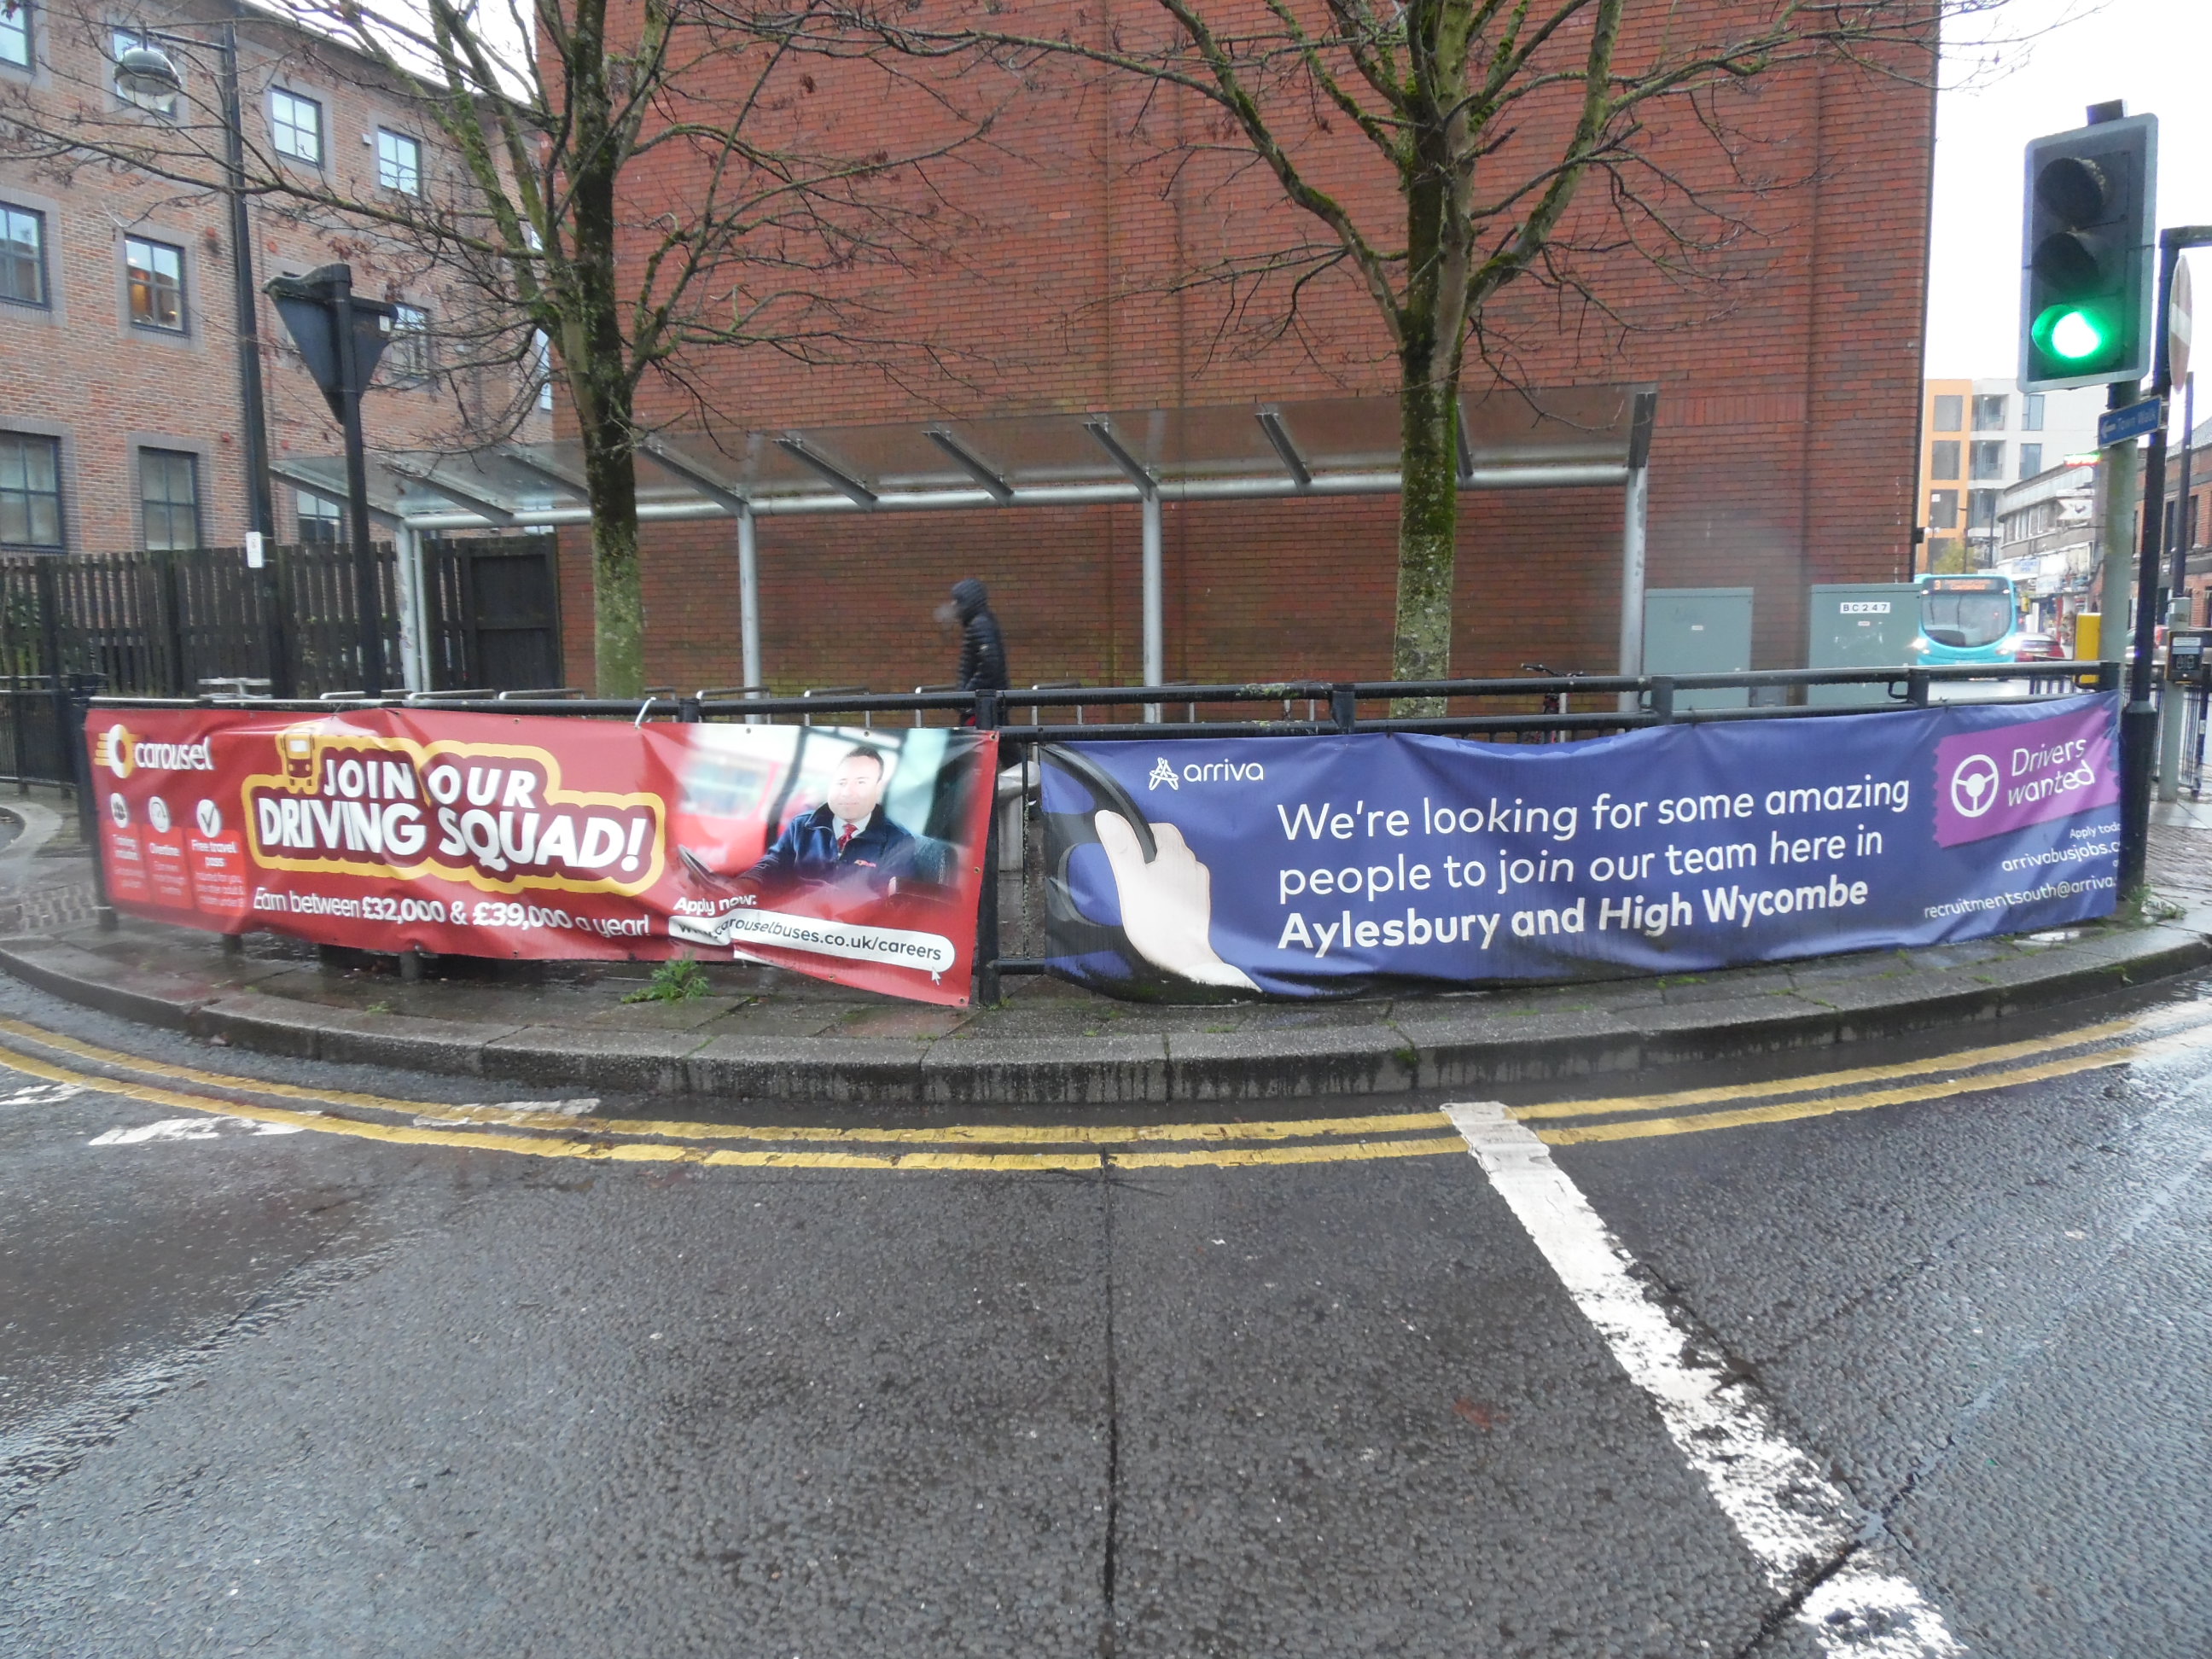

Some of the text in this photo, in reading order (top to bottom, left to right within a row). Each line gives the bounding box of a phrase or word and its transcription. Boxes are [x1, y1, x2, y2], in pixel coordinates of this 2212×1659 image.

[1843, 603, 1888, 612] BC247
[135, 736, 214, 770] carousel
[1183, 758, 1265, 783] arriva
[2011, 739, 2087, 777] Drivers
[323, 759, 537, 809] JOIN OUR
[2008, 759, 2096, 807] wanted
[1277, 774, 1910, 841] We're looking for some amazing
[259, 797, 647, 872] DRIVING SQUAD!
[2069, 825, 2097, 840] Apply
[1279, 824, 1883, 905] people to join our team here in
[253, 887, 288, 911] Earn
[289, 890, 360, 919] between
[362, 896, 446, 924] £32,000
[449, 900, 469, 925] &
[472, 901, 573, 930] £39,000
[575, 916, 593, 932] a
[593, 914, 651, 939] year!
[672, 896, 716, 917] Apply
[1277, 874, 1869, 958] Aylesbury and High Wycombe
